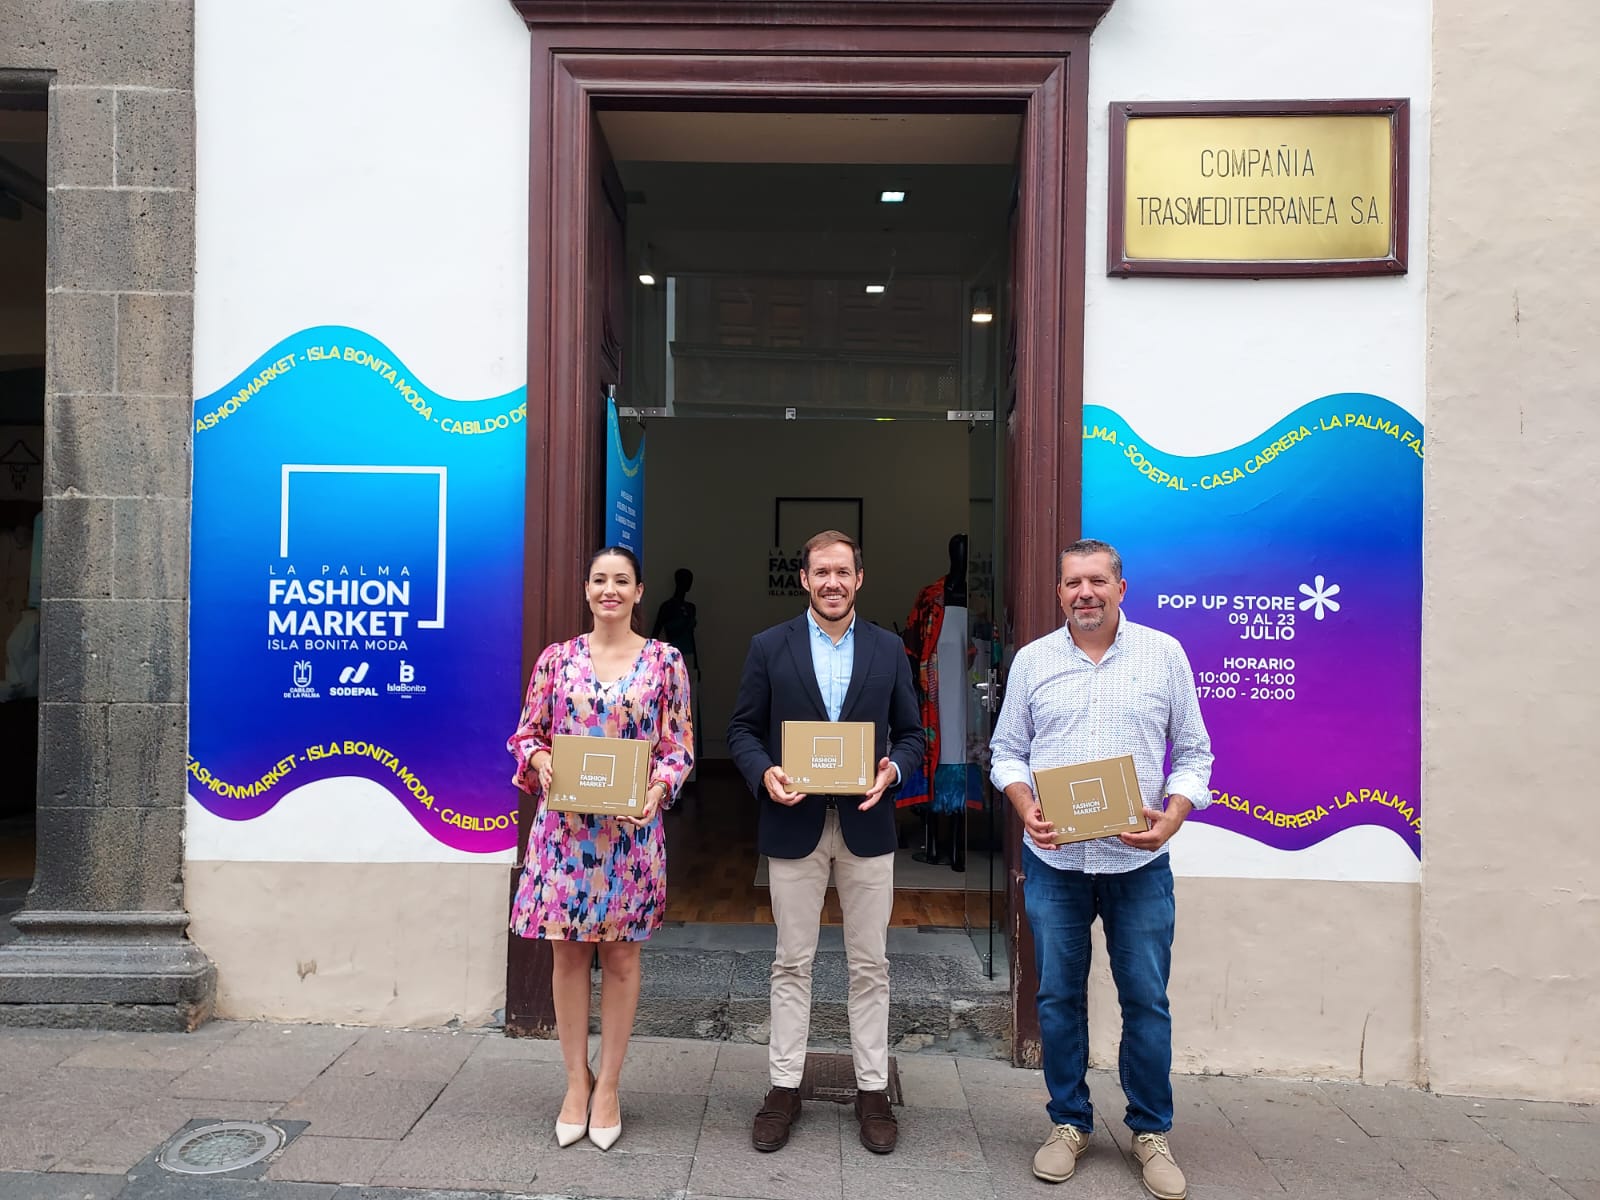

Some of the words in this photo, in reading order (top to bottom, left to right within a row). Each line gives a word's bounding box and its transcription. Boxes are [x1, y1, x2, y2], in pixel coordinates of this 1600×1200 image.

[1201, 144, 1315, 177] COMPAÑIA
[1137, 196, 1338, 226] TRASMEDITERRANEA
[306, 345, 341, 362] ISLA
[343, 347, 397, 385] BONITA
[394, 378, 433, 421] MODA
[441, 414, 509, 435] CABILDO
[1124, 444, 1189, 491] SODEPAL
[1200, 468, 1245, 490] CASA
[1245, 425, 1313, 475] CABRERA
[1320, 415, 1343, 431] LA
[1345, 413, 1400, 439] PALMA
[269, 565, 296, 575] LA
[322, 565, 410, 577] PALMA
[769, 558, 803, 572] FAS
[268, 579, 410, 605] FASHION
[1158, 595, 1197, 610] POP
[1202, 596, 1229, 610] UP
[1233, 596, 1295, 611] STORE
[268, 610, 409, 636] MARKET
[1228, 613, 1247, 625] 09
[1253, 614, 1272, 625] AL
[1277, 614, 1295, 625] 23
[1240, 626, 1295, 640] JULIO
[268, 639, 299, 650] ISLA
[304, 639, 359, 651] BONITA
[364, 640, 408, 651] MODA
[1223, 657, 1295, 670] HORARIO
[1198, 671, 1240, 684] 10:00
[1254, 673, 1295, 685] 14:00
[329, 687, 379, 697] SODEPAL
[1196, 686, 1236, 699] 17:00
[1250, 687, 1295, 700] 20:00
[579, 780, 606, 788] MARKET
[580, 774, 607, 782] FASHION
[306, 741, 341, 762] ISLA
[343, 741, 400, 772] BONITA
[397, 766, 435, 811] MODA
[441, 808, 509, 832] CABILDO
[1072, 800, 1100, 810] FASHION
[1073, 806, 1101, 816] MARKET
[1253, 804, 1329, 828] CABRERA
[1334, 791, 1358, 809] LA
[1359, 788, 1414, 822] PALMA
